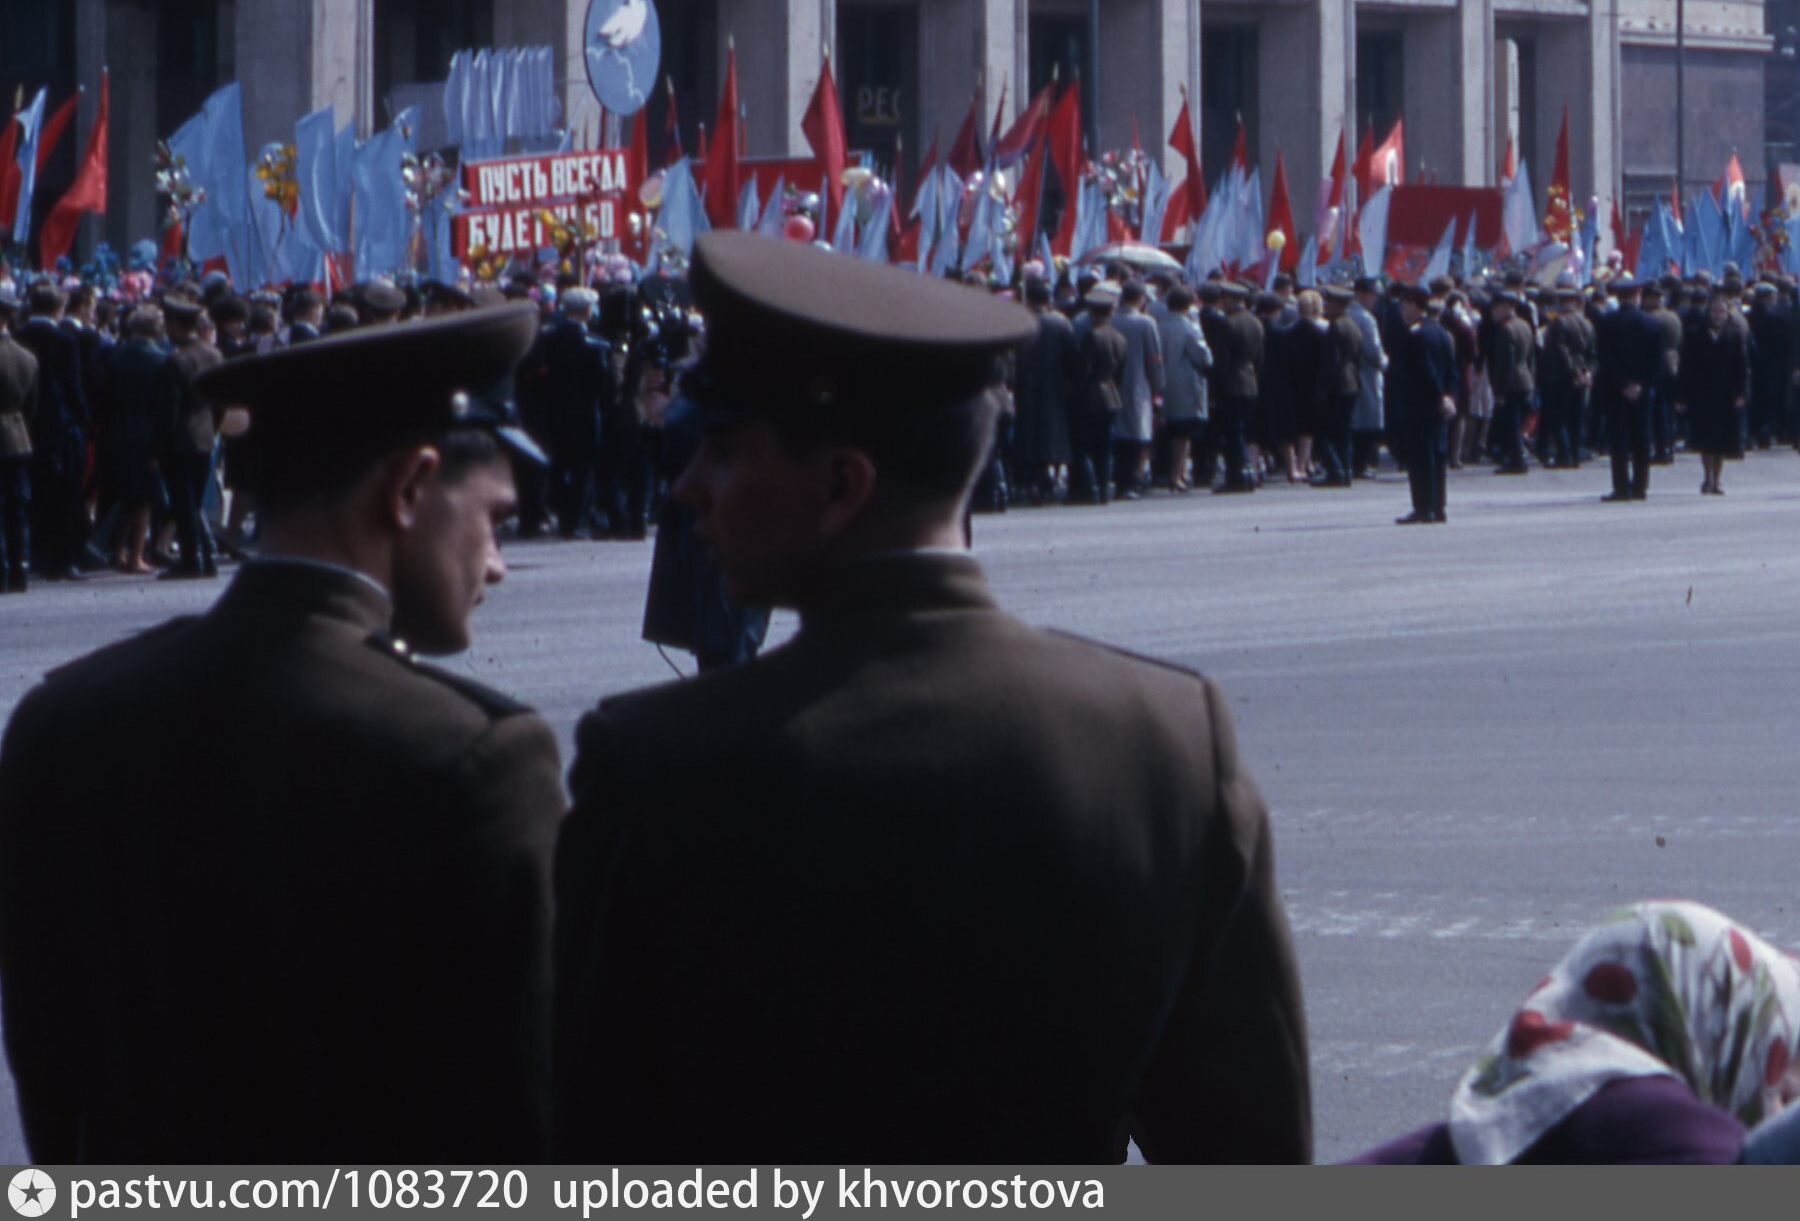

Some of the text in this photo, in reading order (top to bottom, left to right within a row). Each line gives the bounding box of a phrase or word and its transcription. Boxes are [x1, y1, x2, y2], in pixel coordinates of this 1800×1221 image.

[478, 153, 626, 205] ПУСТЬ ВСЕГДА
[468, 208, 542, 253] БУДЕТ
